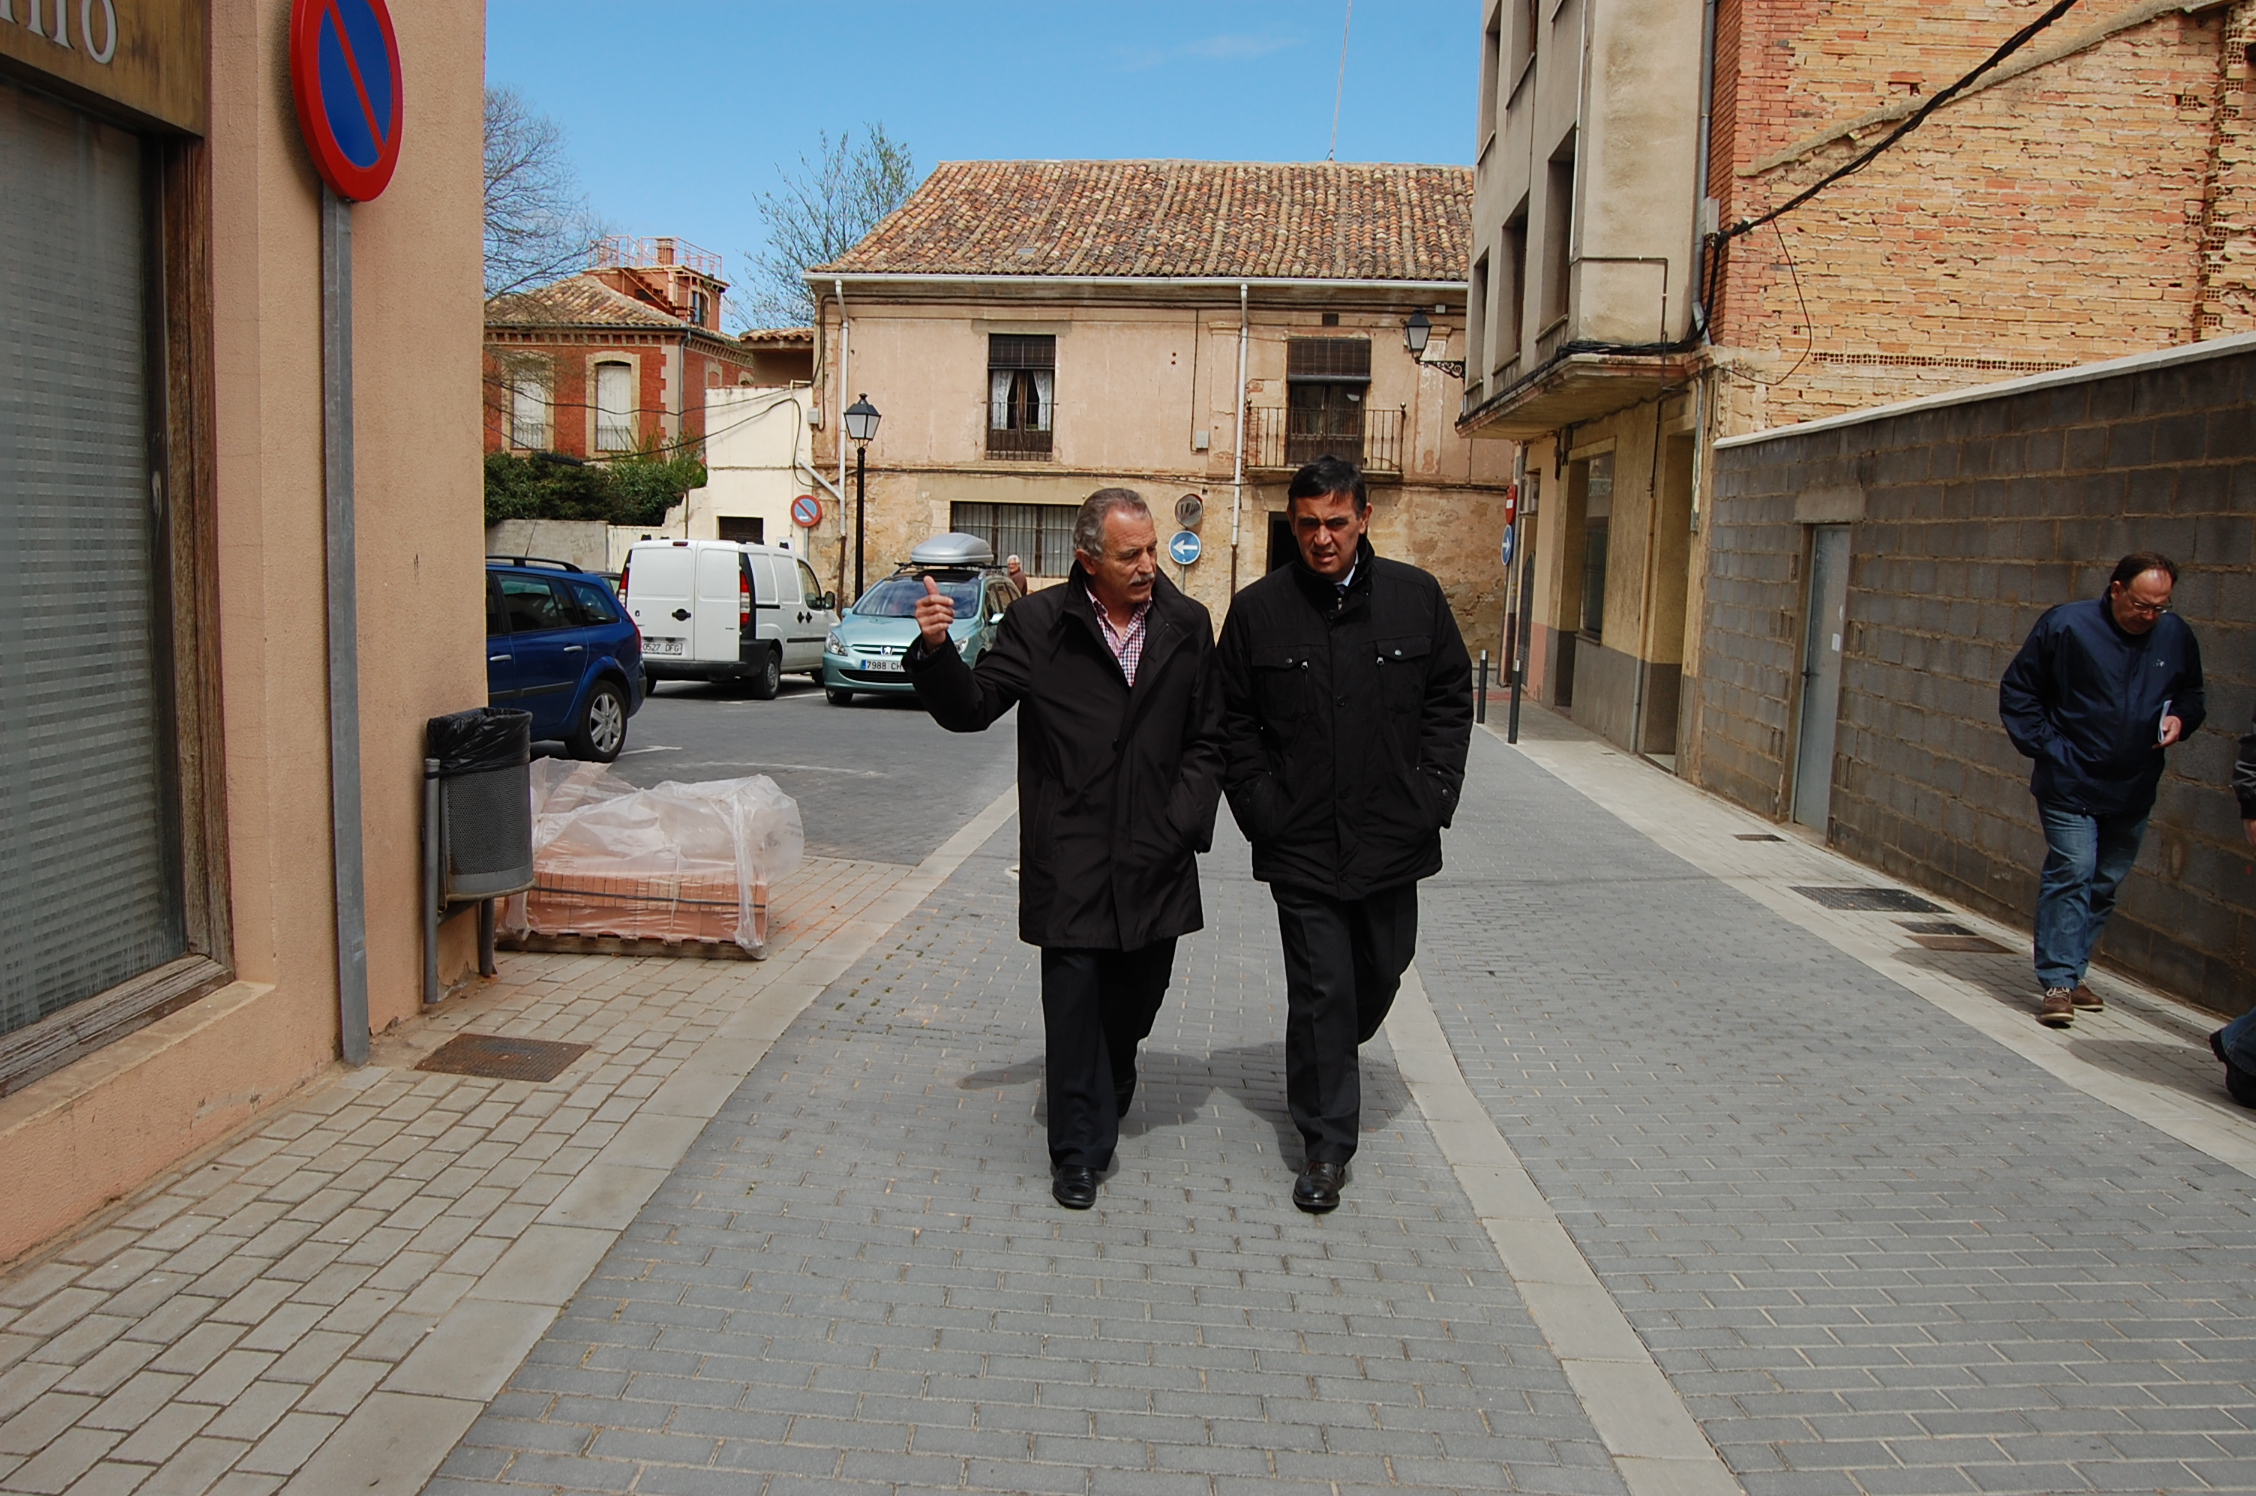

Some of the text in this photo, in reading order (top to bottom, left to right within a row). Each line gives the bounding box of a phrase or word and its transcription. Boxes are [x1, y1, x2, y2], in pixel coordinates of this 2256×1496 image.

[643, 643, 661, 652] 0527
[866, 661, 902, 671] 7988 CH
